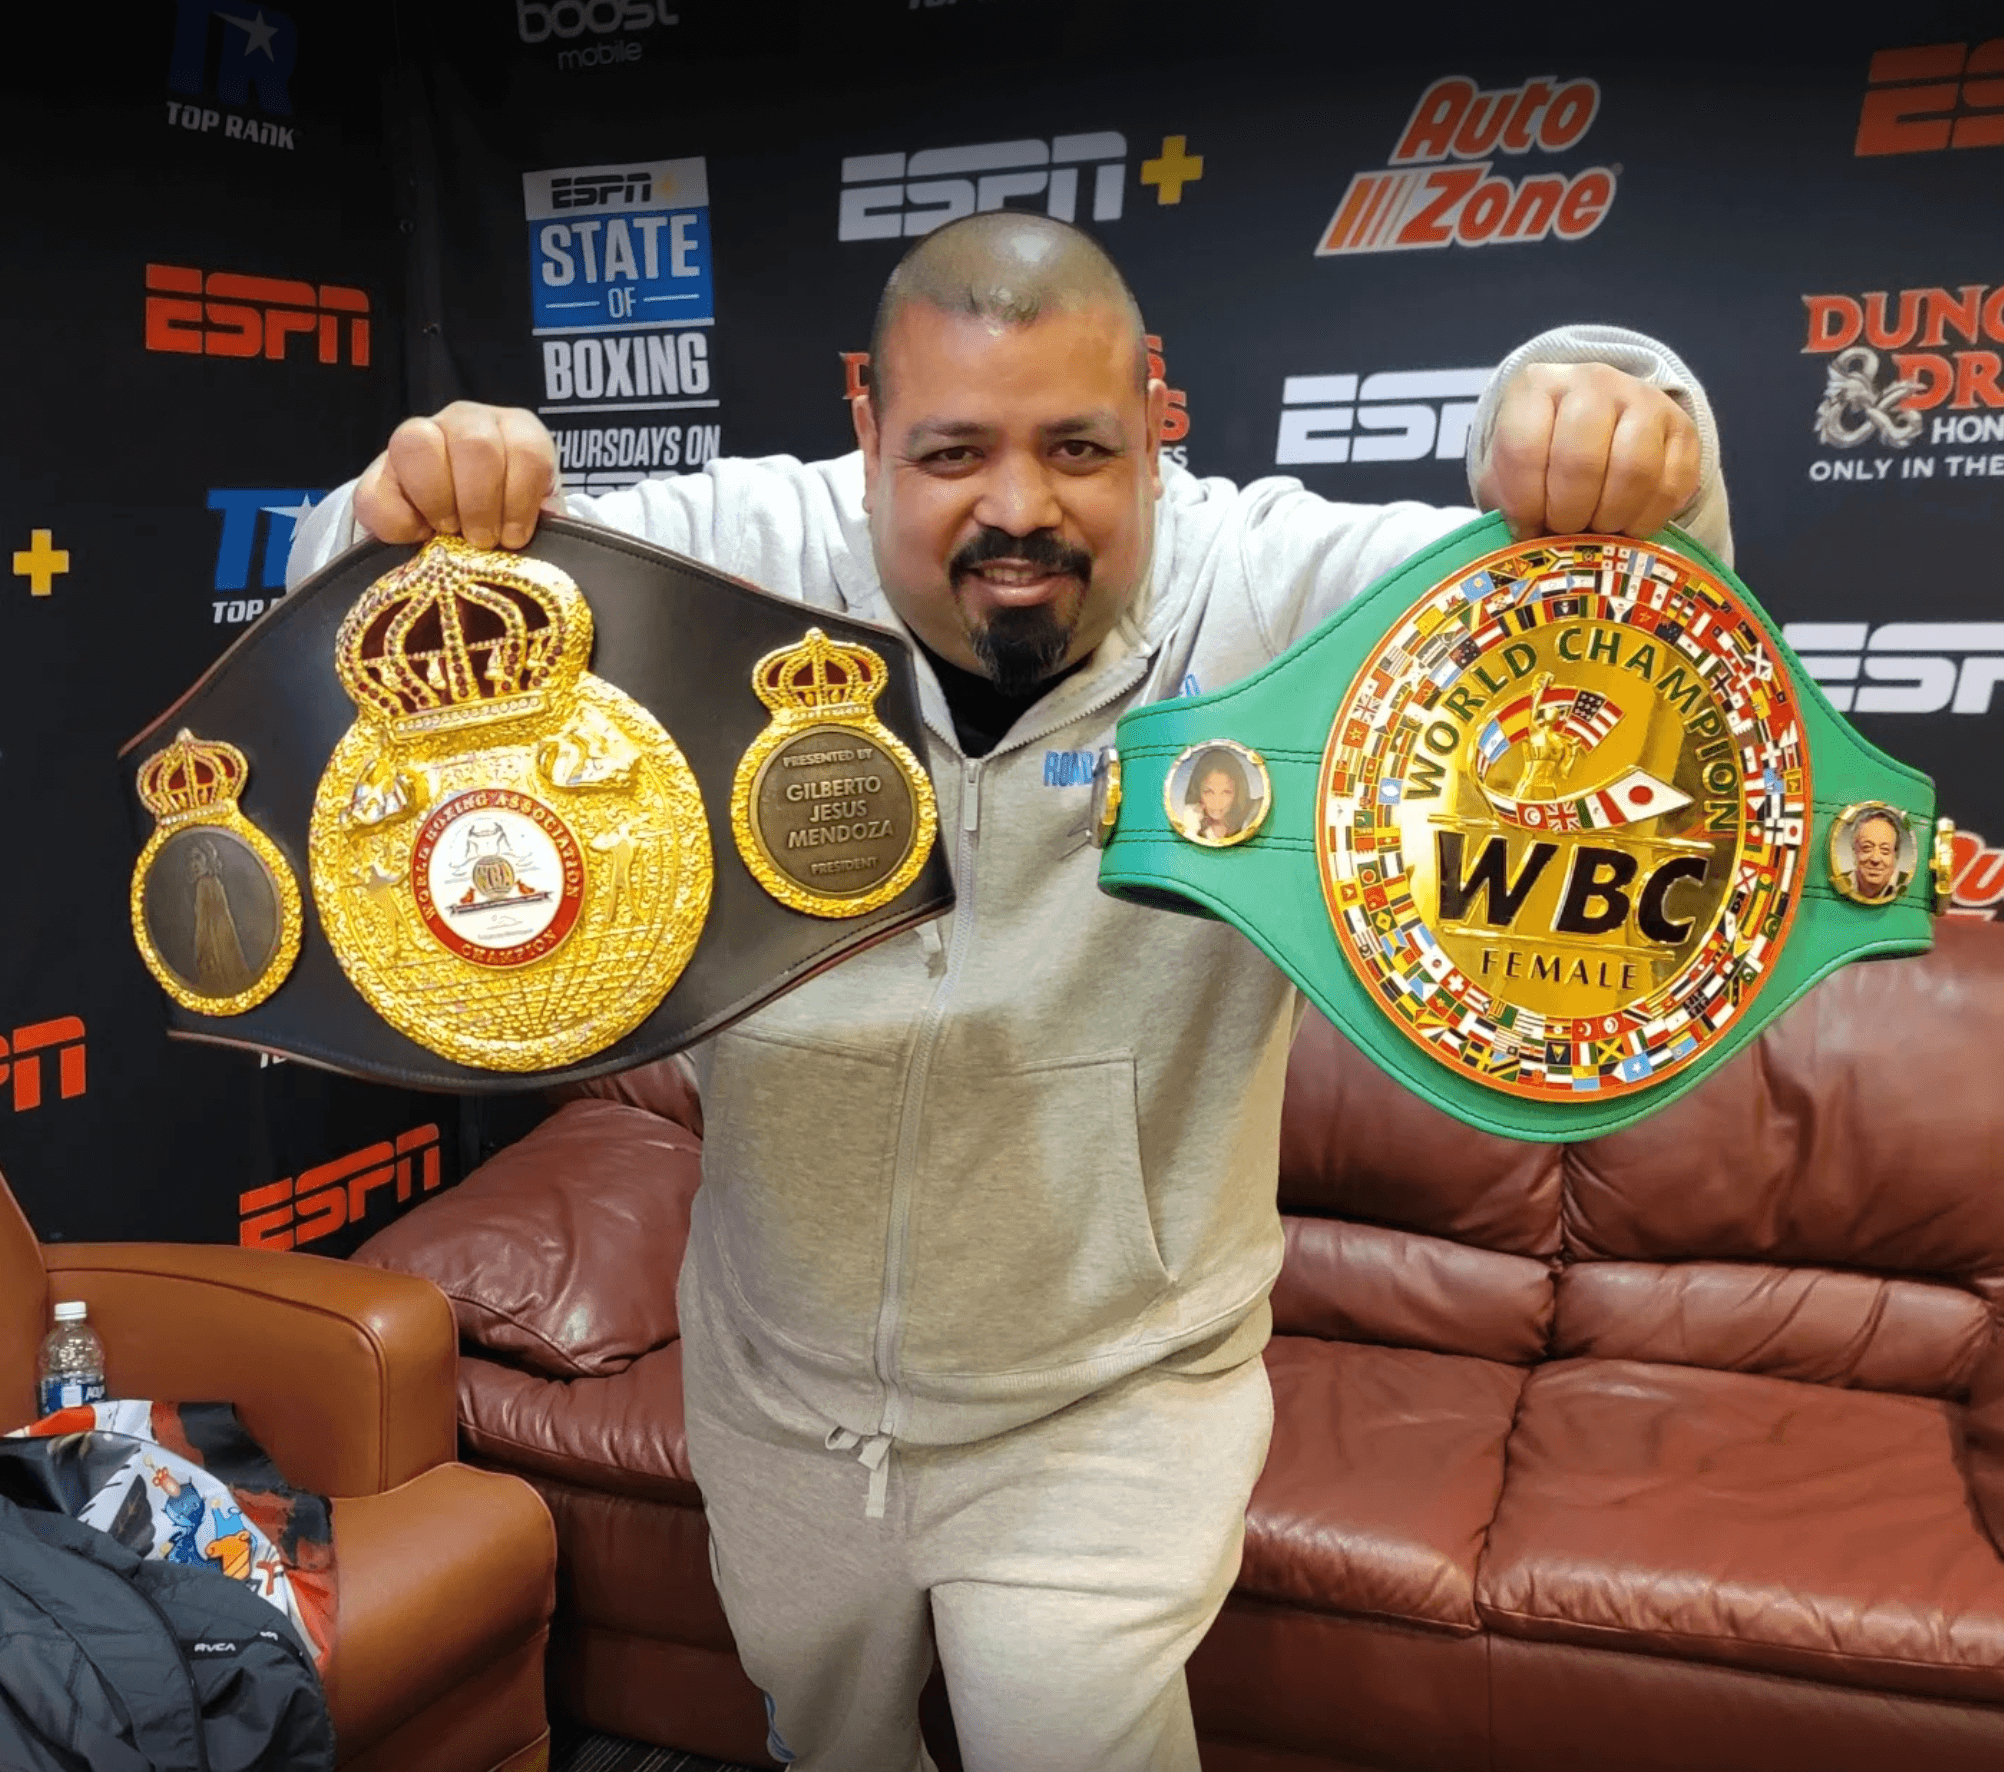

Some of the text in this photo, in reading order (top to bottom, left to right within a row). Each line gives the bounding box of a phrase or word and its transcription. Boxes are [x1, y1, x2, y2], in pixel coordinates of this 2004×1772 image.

[557, 40, 643, 71] mobile
[166, 100, 295, 151] TOP RANK
[1388, 75, 1601, 166] Auto
[1393, 162, 1618, 248] Zone
[540, 213, 701, 287] STATE
[145, 263, 370, 367] ESPN
[608, 286, 637, 319] OF
[543, 332, 711, 400] BOXING
[685, 424, 721, 466] ON
[1809, 454, 2004, 482] ONLY IN THE
[212, 599, 264, 624] TOP
[1403, 627, 1739, 832] WORLD CHAMPION
[783, 748, 873, 768] PRESENTED BY
[786, 775, 882, 801] GILBERTO
[809, 800, 868, 823] JESUS
[788, 819, 894, 849] MENDOZA
[811, 857, 879, 875] PRESIDENT
[1435, 829, 1710, 946] WBC
[1480, 947, 1639, 991] FEMALE
[239, 1122, 441, 1252] ESPN
